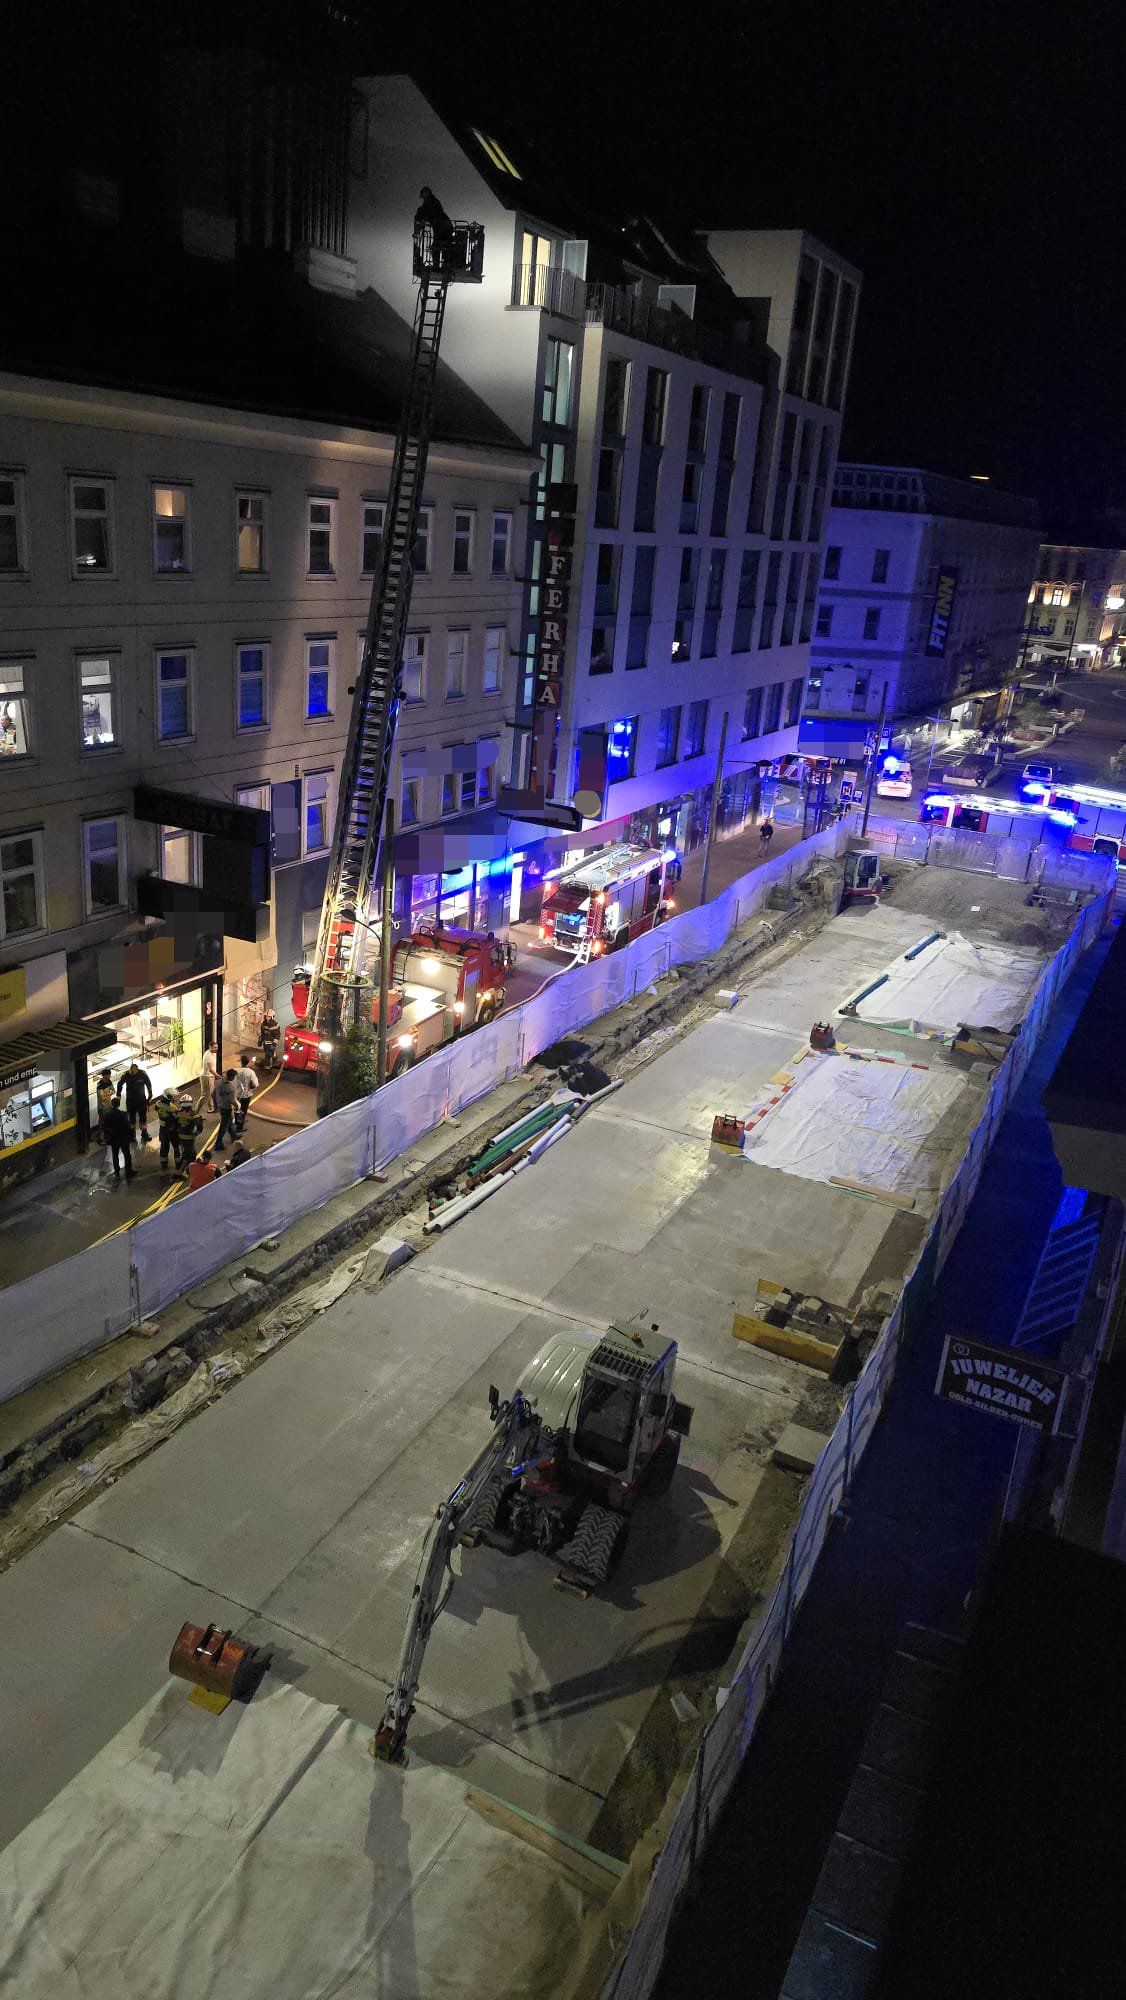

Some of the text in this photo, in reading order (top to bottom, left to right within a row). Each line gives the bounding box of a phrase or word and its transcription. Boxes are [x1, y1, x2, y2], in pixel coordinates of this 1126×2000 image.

[5, 1072, 20, 1085] und
[951, 1358, 1056, 1405] JUWELIER
[966, 1378, 1032, 1413] NAZAR
